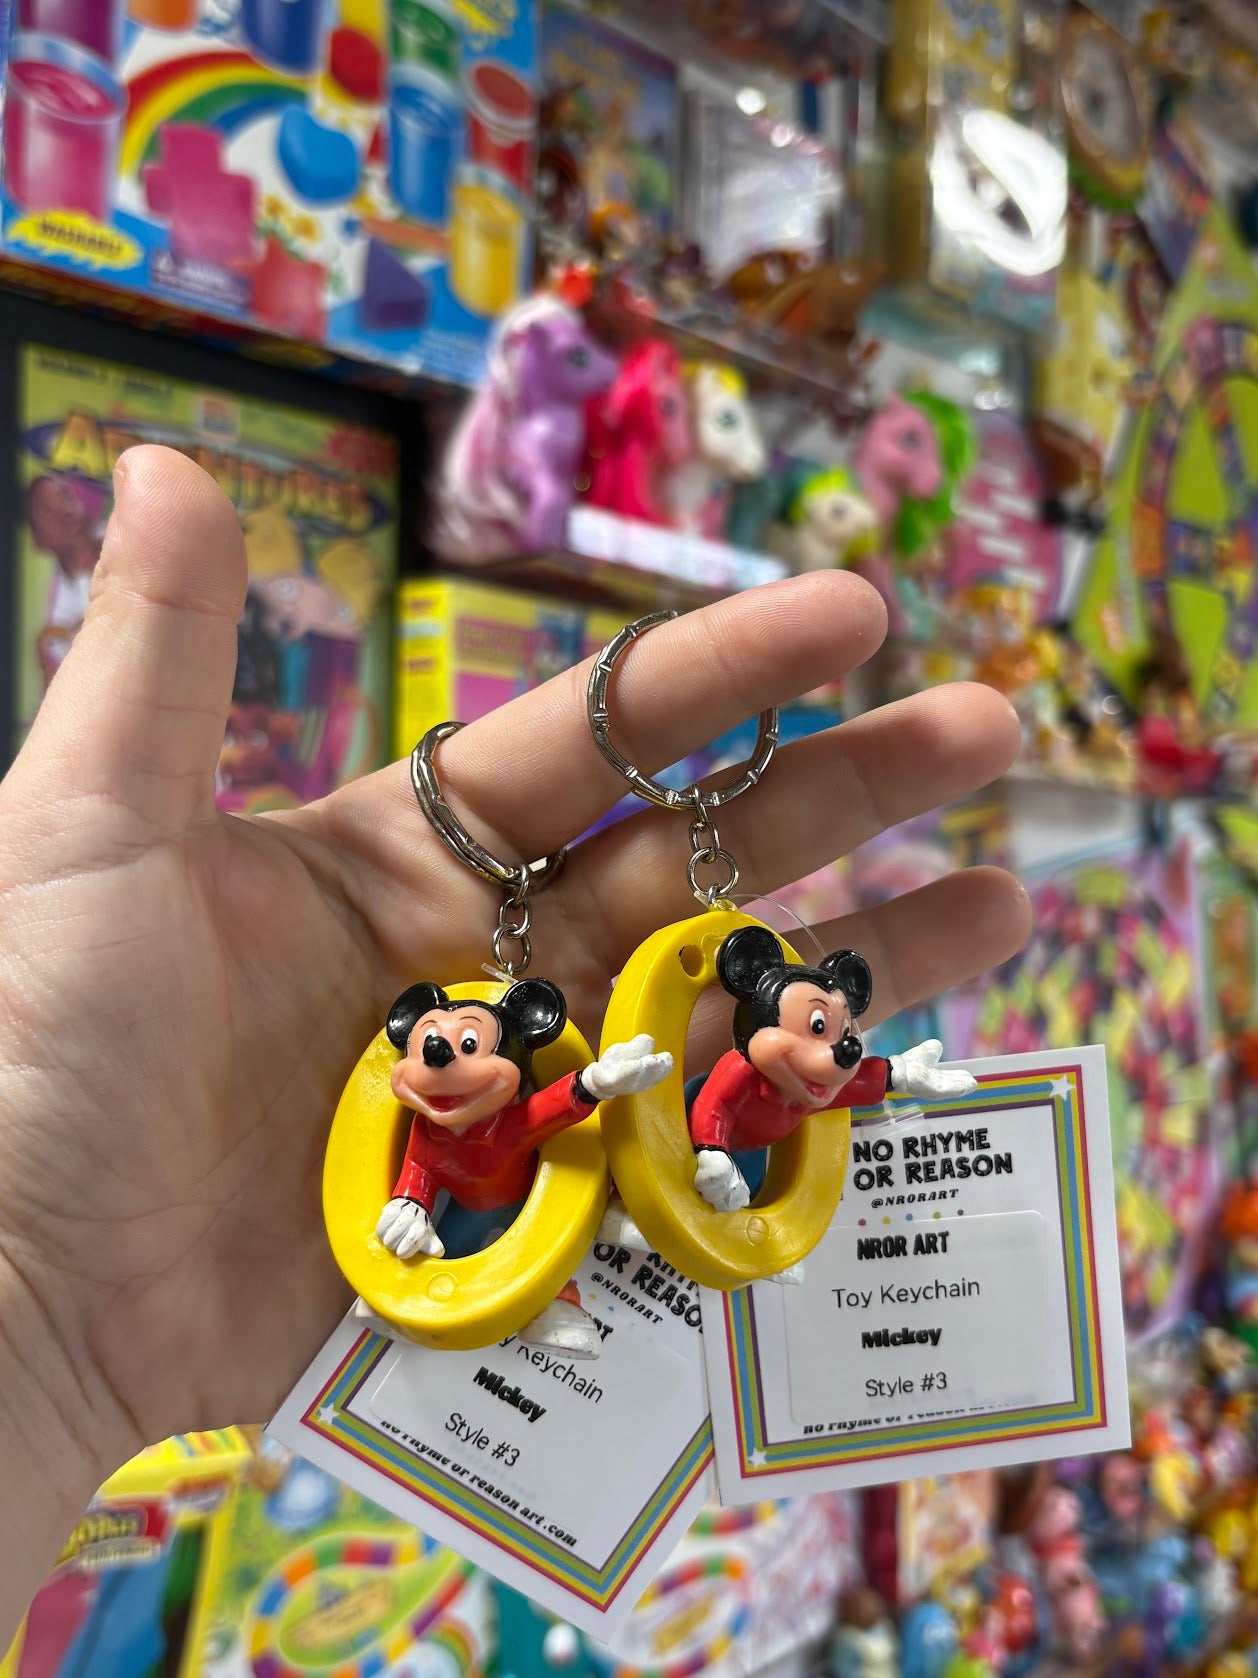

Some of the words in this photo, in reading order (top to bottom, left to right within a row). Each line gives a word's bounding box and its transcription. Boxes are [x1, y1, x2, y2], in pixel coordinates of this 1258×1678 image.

[853, 1138, 894, 1163] NO
[902, 1127, 991, 1159] RHYME
[853, 1164, 895, 1191] OR
[905, 1152, 1013, 1185] REASON
[871, 1188, 959, 1209] @NRORART
[857, 1235, 907, 1261] NROR
[913, 1230, 950, 1256] ART
[590, 1272, 664, 1325] @NRORART
[593, 1242, 632, 1274] OR
[631, 1263, 703, 1334] REASO
[832, 1286, 873, 1308] Toy
[880, 1277, 980, 1304] Keychain
[861, 1326, 943, 1349] Mickey
[472, 1366, 547, 1424] Mickey
[865, 1376, 914, 1398] Style
[920, 1371, 948, 1393] #3
[445, 1412, 490, 1451] Style
[491, 1440, 521, 1468] #3
[803, 1423, 824, 1435] no
[450, 1462, 470, 1479] or
[469, 1474, 520, 1510] reason
